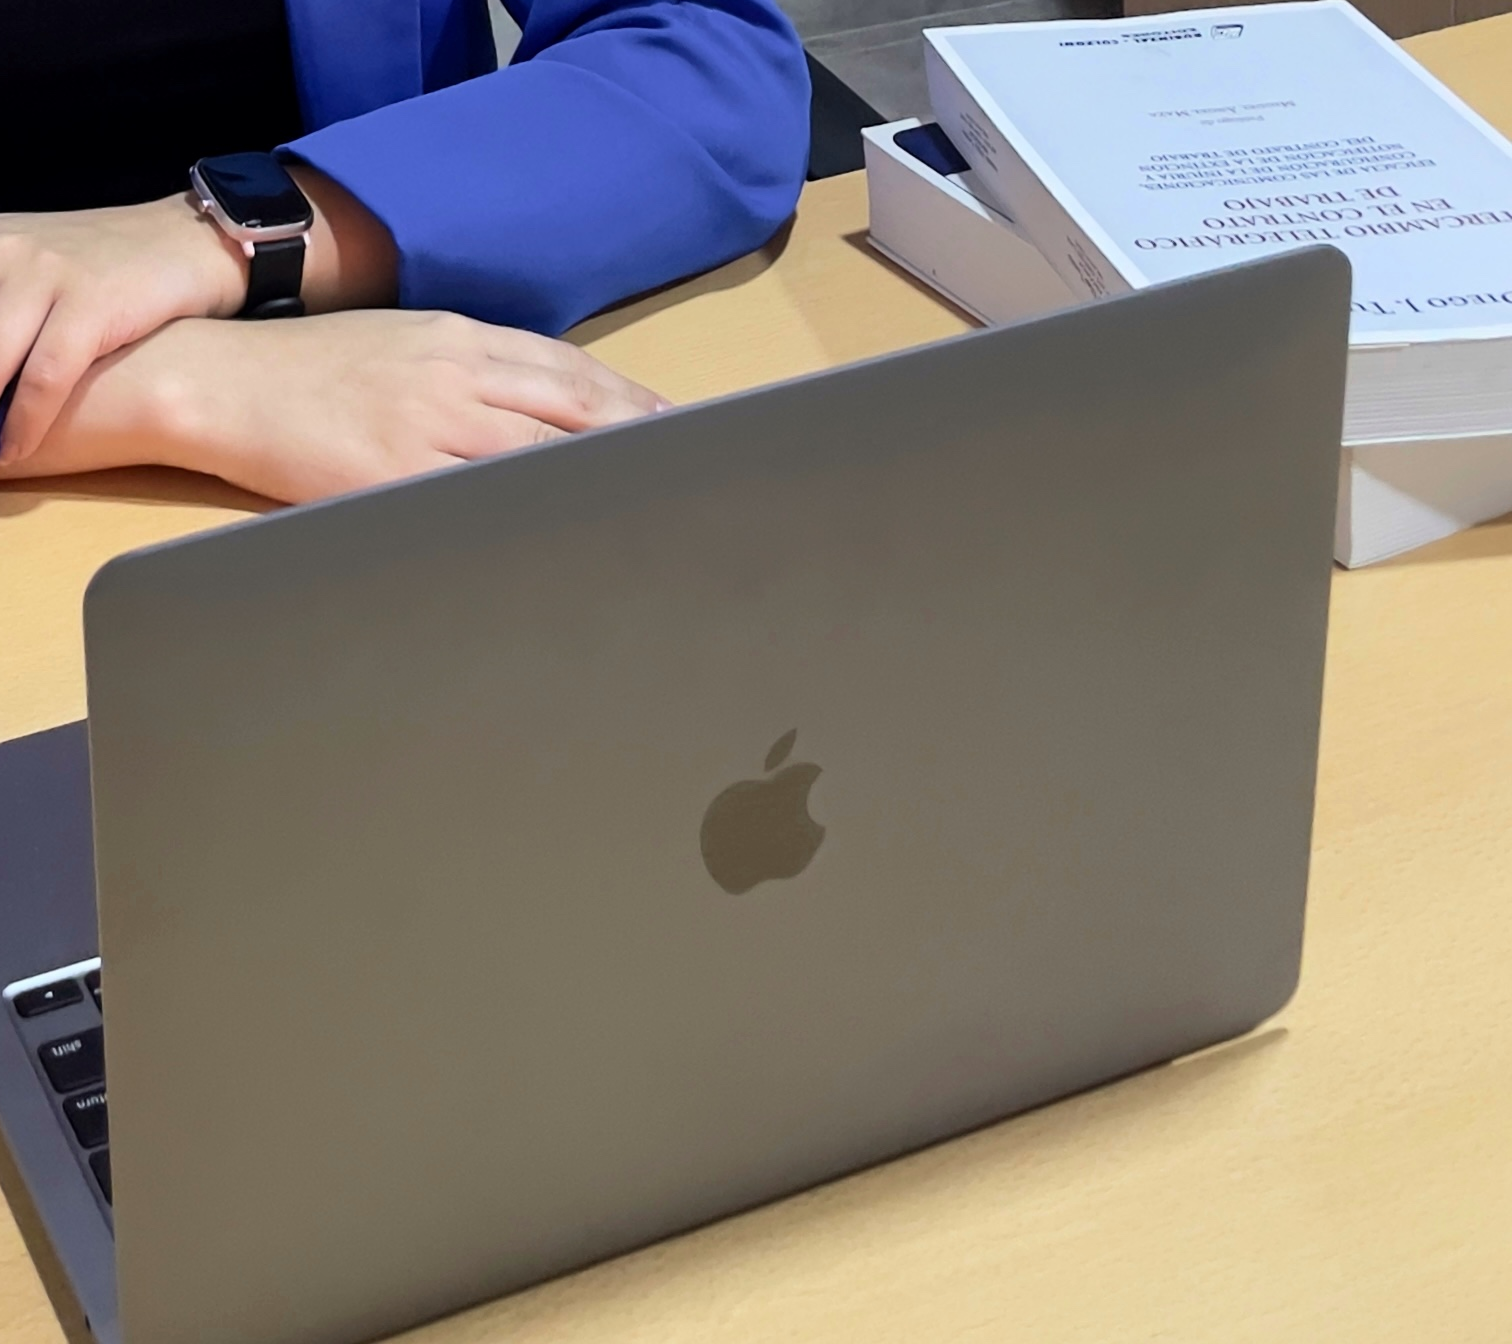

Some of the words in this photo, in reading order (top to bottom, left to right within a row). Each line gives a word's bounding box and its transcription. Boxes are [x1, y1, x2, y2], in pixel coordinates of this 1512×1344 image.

[1120, 27, 1198, 40] EDITORES
[1133, 32, 1203, 45] RUBINZAL
[1058, 38, 1120, 48] CULZONI
[1250, 138, 1342, 155] CONTRATO
[1343, 135, 1375, 147] DEL
[1147, 150, 1220, 164] TRABAJO
[1222, 148, 1248, 159] DE
[1257, 155, 1279, 165] DE
[1282, 142, 1404, 163] NOTIFICACIÓN
[1137, 159, 1230, 175] EXTINCIÓN
[1232, 158, 1253, 168] LA
[1277, 150, 1417, 172] CONFIGURACIÓN
[1360, 158, 1438, 175] EFICACIA
[1160, 169, 1223, 181] INJURIA
[1226, 167, 1247, 178] LA
[1251, 164, 1274, 175] DE
[1297, 169, 1330, 180] LAS
[1335, 167, 1358, 178] DE
[1354, 184, 1402, 202] DE
[1221, 191, 1355, 212] TRABAJO
[1412, 197, 1456, 213] EN
[1366, 202, 1406, 219] EL
[1202, 207, 1364, 231] CONTRATO
[1134, 226, 1340, 252] TELEGRÁFICO
[1394, 297, 1425, 314] J.
[52, 1039, 83, 1057] shift
[76, 1093, 108, 1111] turn
